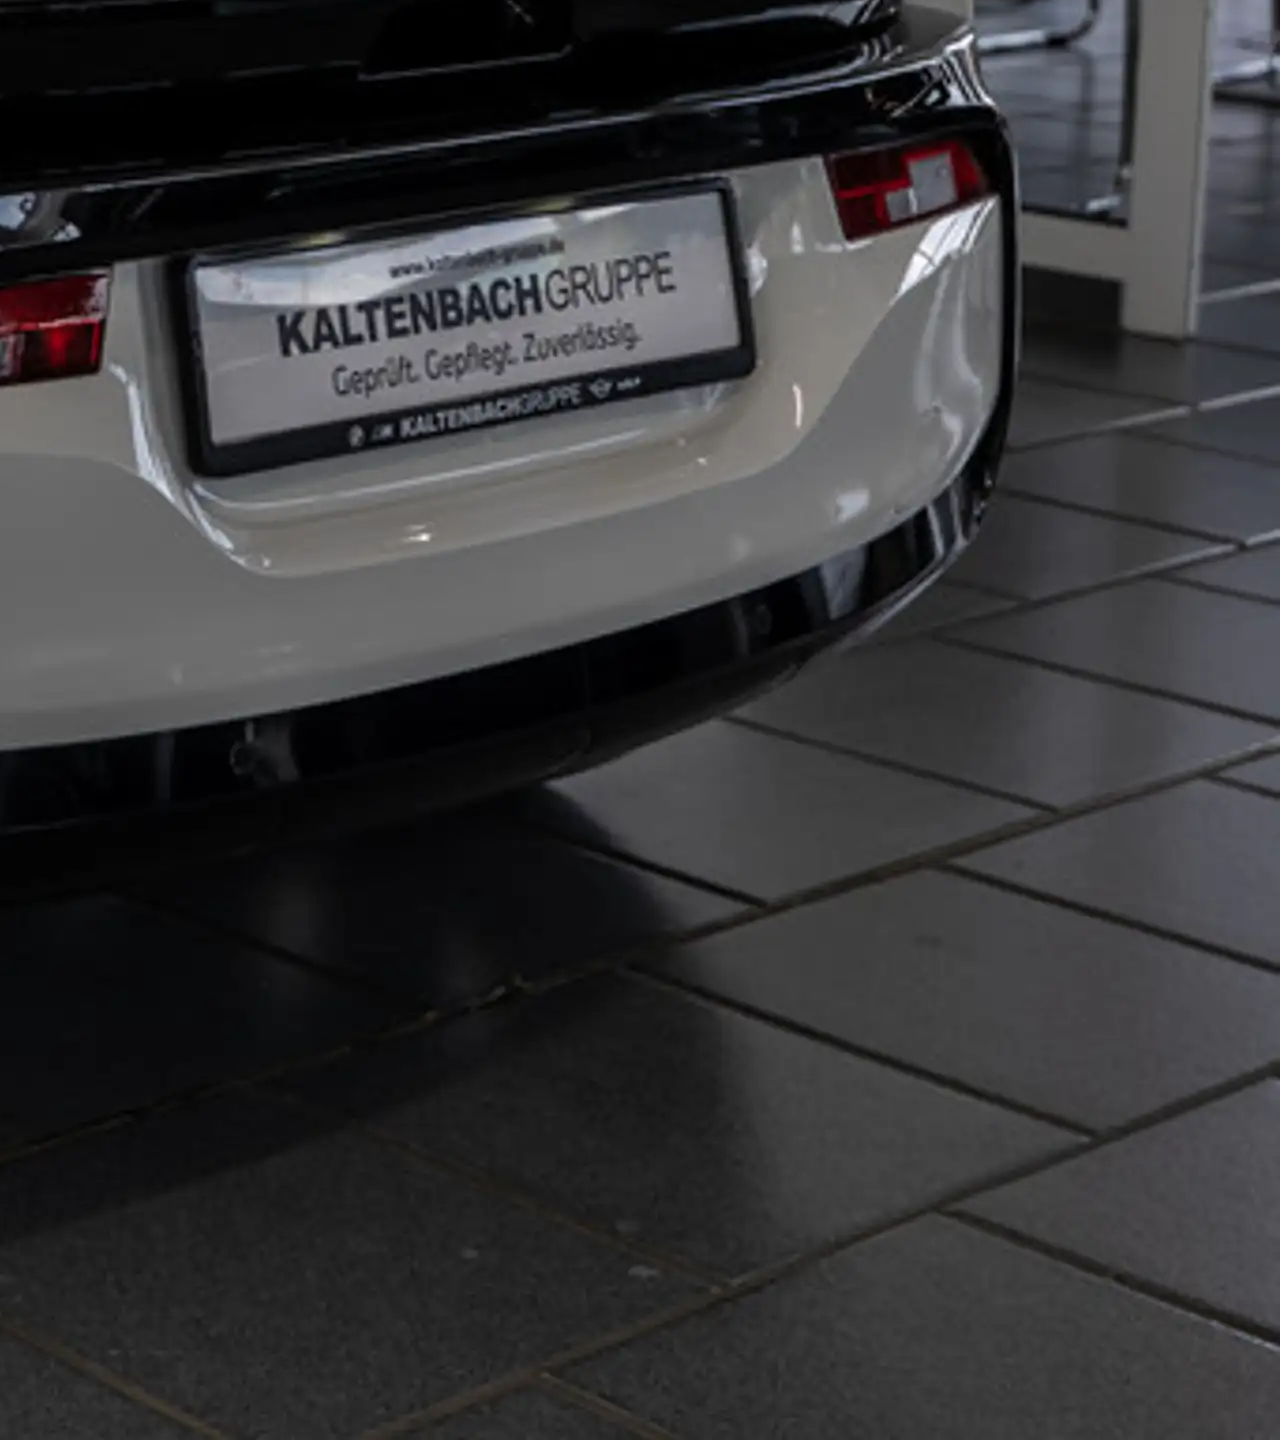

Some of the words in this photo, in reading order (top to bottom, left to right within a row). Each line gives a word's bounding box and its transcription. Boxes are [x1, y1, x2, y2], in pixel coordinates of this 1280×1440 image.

[276, 251, 677, 358] KALTENBACHGRUPPE
[331, 356, 421, 400] Geprüft.
[425, 341, 518, 382] Gepflegt.
[522, 317, 643, 362] Zuverlässig.
